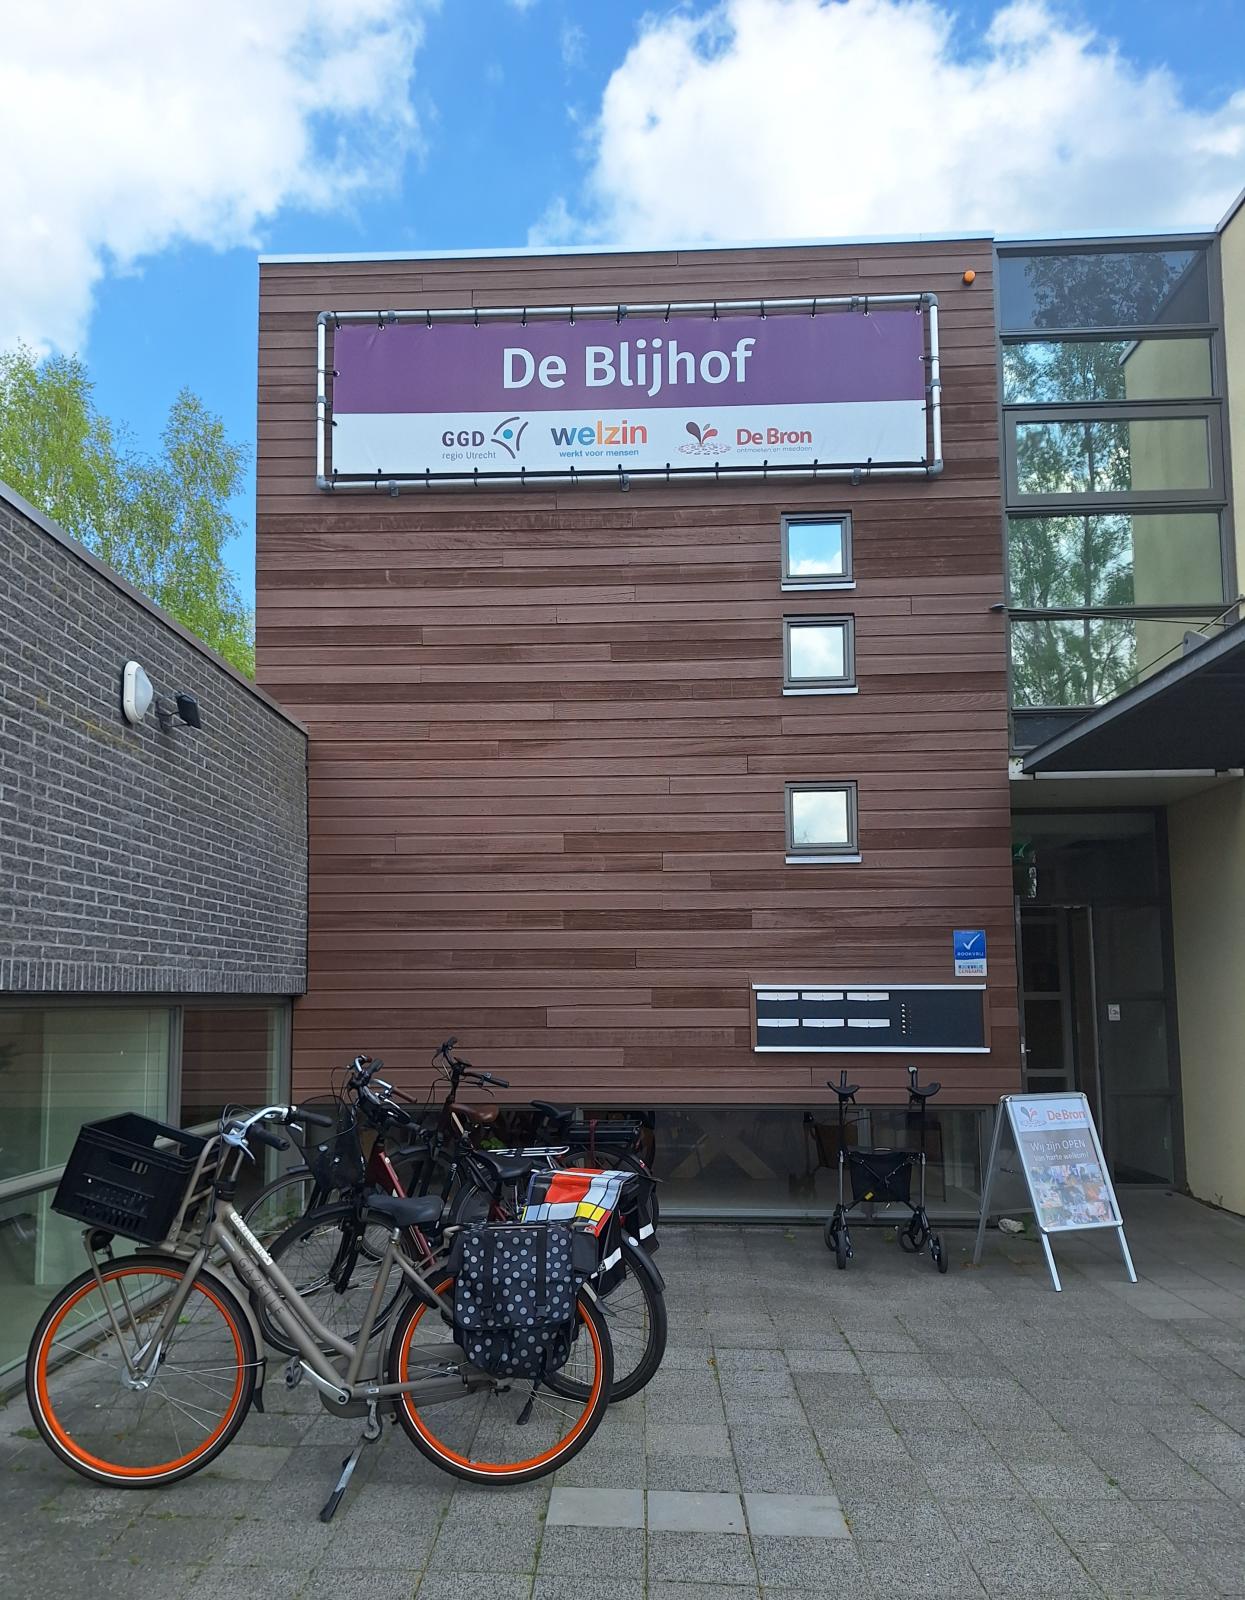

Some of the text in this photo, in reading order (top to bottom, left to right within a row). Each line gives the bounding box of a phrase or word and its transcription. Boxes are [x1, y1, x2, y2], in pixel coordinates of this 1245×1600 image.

[503, 337, 756, 397] De Blijhof
[441, 430, 485, 447] GGD
[550, 420, 648, 446] welzin
[442, 450, 497, 461] regio Utrecht
[559, 450, 583, 458] werkt
[606, 449, 639, 457] mensen
[1062, 1139, 1086, 1149] OPEN
[239, 1258, 285, 1315] GAZELLE
